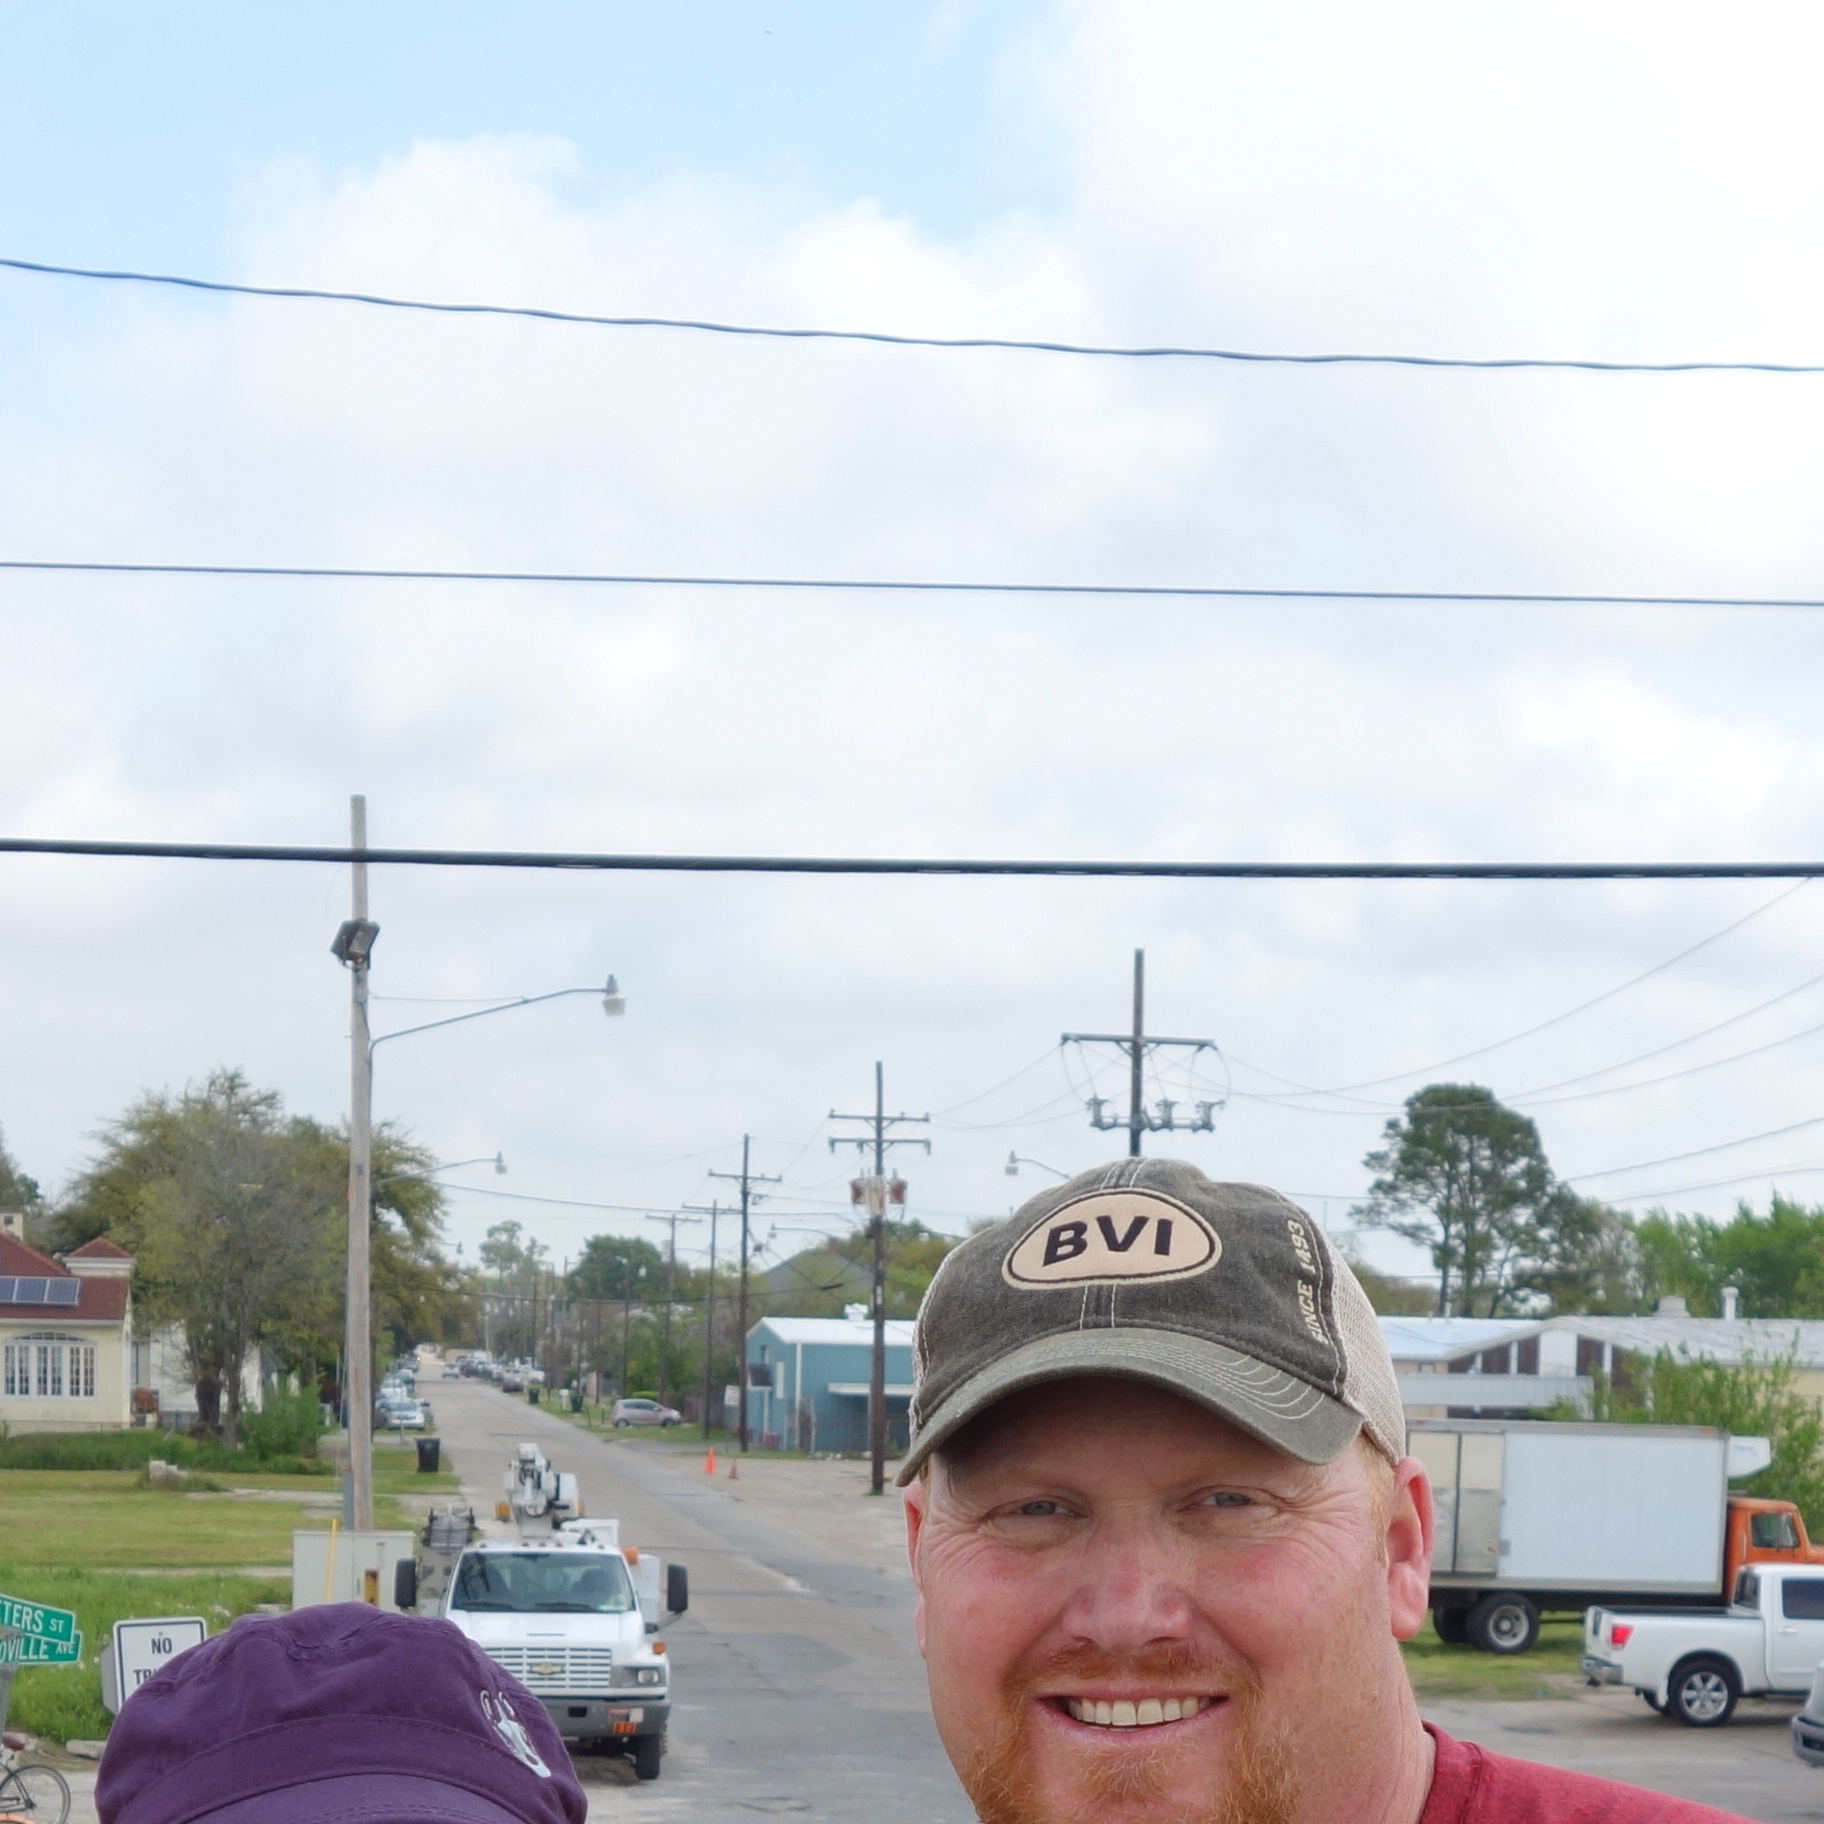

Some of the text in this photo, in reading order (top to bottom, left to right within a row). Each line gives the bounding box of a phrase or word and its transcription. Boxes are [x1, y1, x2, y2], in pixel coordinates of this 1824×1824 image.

[1043, 1214, 1174, 1267] BVI
[1298, 1279, 1329, 1345] SINCE
[49, 1618, 65, 1633] ST
[55, 1641, 75, 1654] AVE
[151, 1637, 173, 1654] NO
